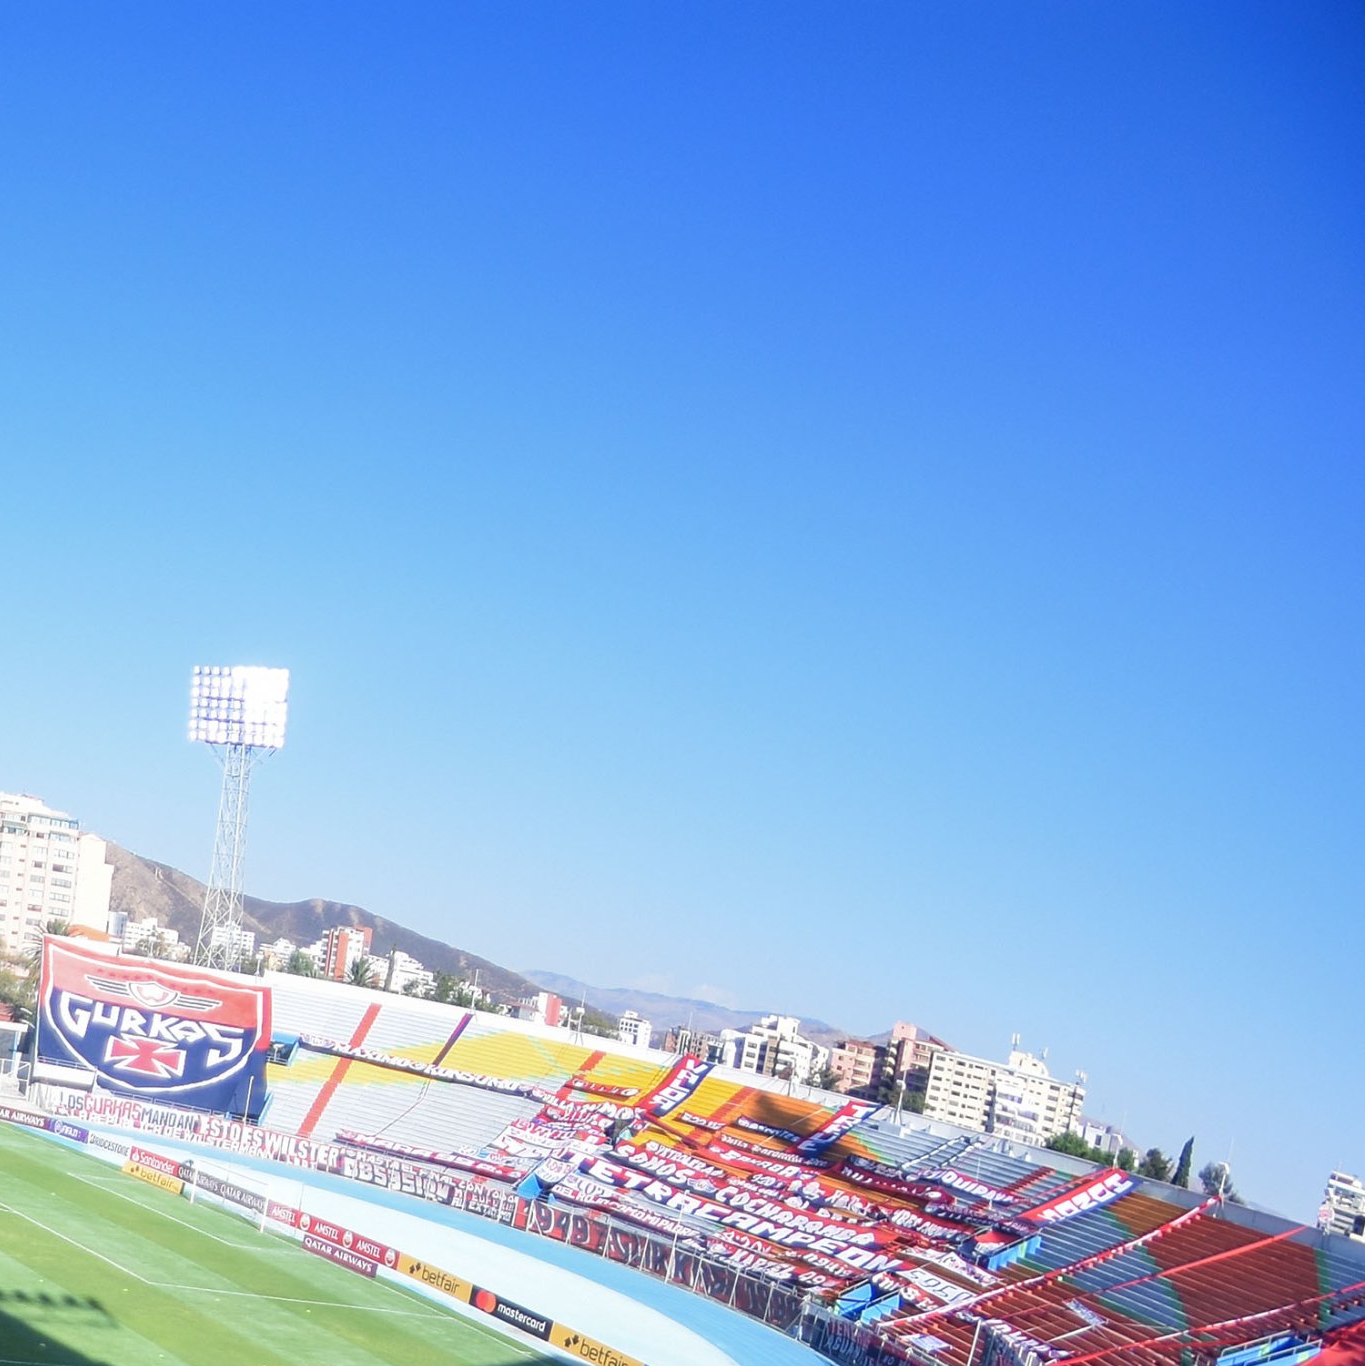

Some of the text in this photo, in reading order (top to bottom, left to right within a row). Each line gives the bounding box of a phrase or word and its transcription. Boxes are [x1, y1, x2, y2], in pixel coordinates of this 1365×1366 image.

[61, 990, 245, 1067] GURKAS
[11, 1110, 45, 1128] AIRWAYS
[89, 1133, 130, 1157] BRIDGESTONE
[264, 1129, 339, 1168] WILSTER
[139, 1150, 176, 1175] Santander
[141, 1167, 173, 1189] betfair
[314, 1222, 339, 1241] AMSTEL
[304, 1236, 373, 1273] QATAR AIRWAYS
[356, 1239, 381, 1259] AMSTEL
[421, 1265, 461, 1294] betfair
[497, 1302, 546, 1333] mastercard
